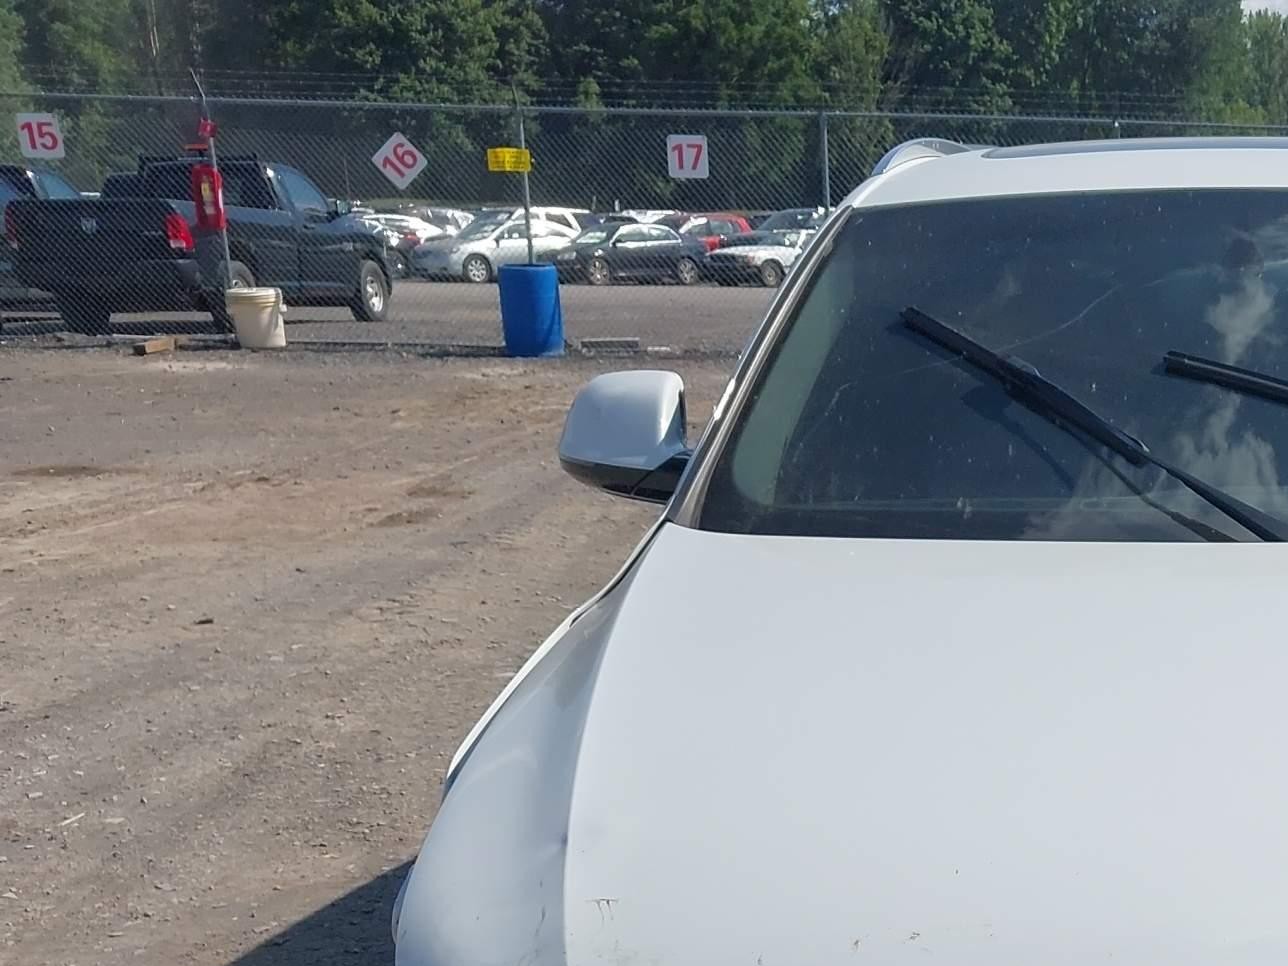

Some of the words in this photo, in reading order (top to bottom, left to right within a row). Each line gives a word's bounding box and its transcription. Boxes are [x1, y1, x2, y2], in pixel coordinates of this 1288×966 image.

[20, 121, 58, 151] 15
[382, 142, 418, 179] 16
[671, 143, 704, 171] 17
